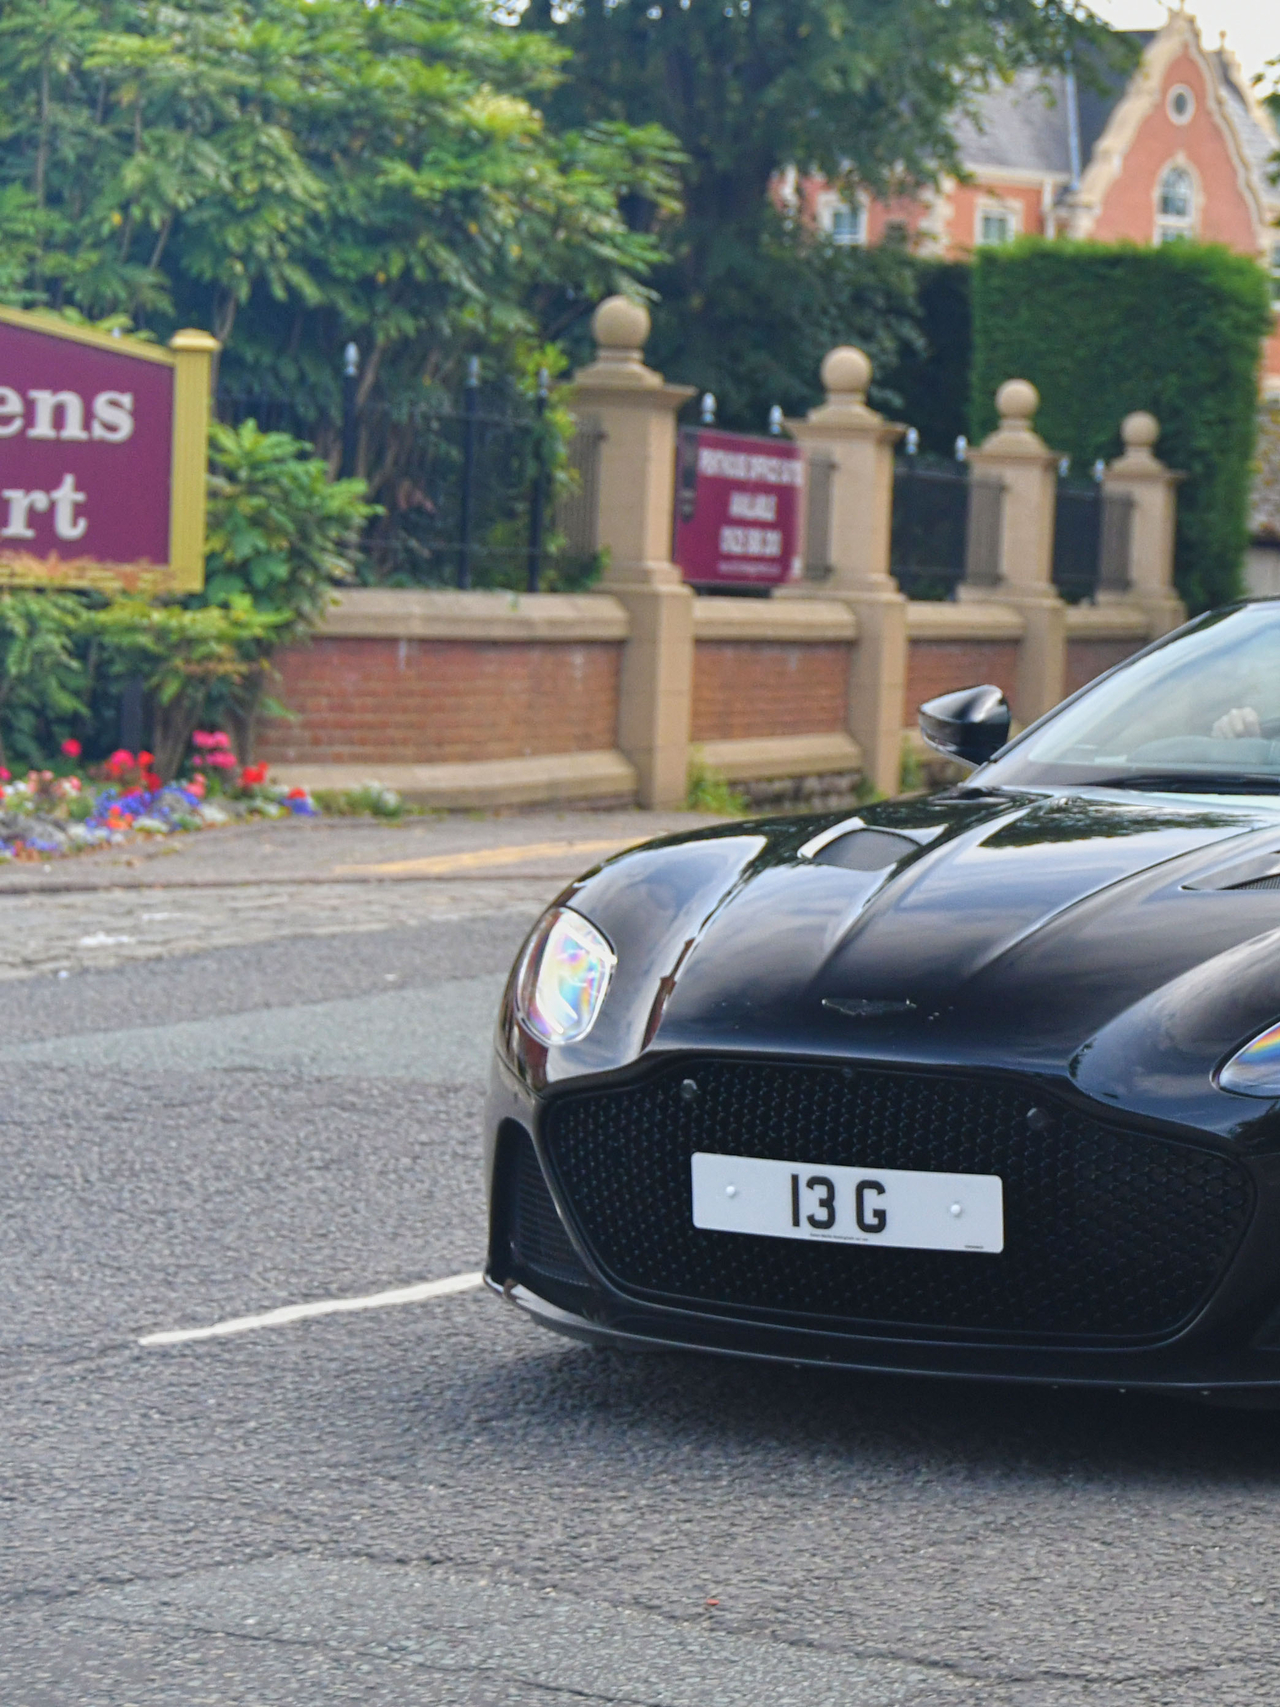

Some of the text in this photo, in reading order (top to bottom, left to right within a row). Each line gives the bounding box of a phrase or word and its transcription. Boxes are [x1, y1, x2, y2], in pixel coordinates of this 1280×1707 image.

[1, 473, 87, 541] rt
[791, 1173, 887, 1234] 13 G
